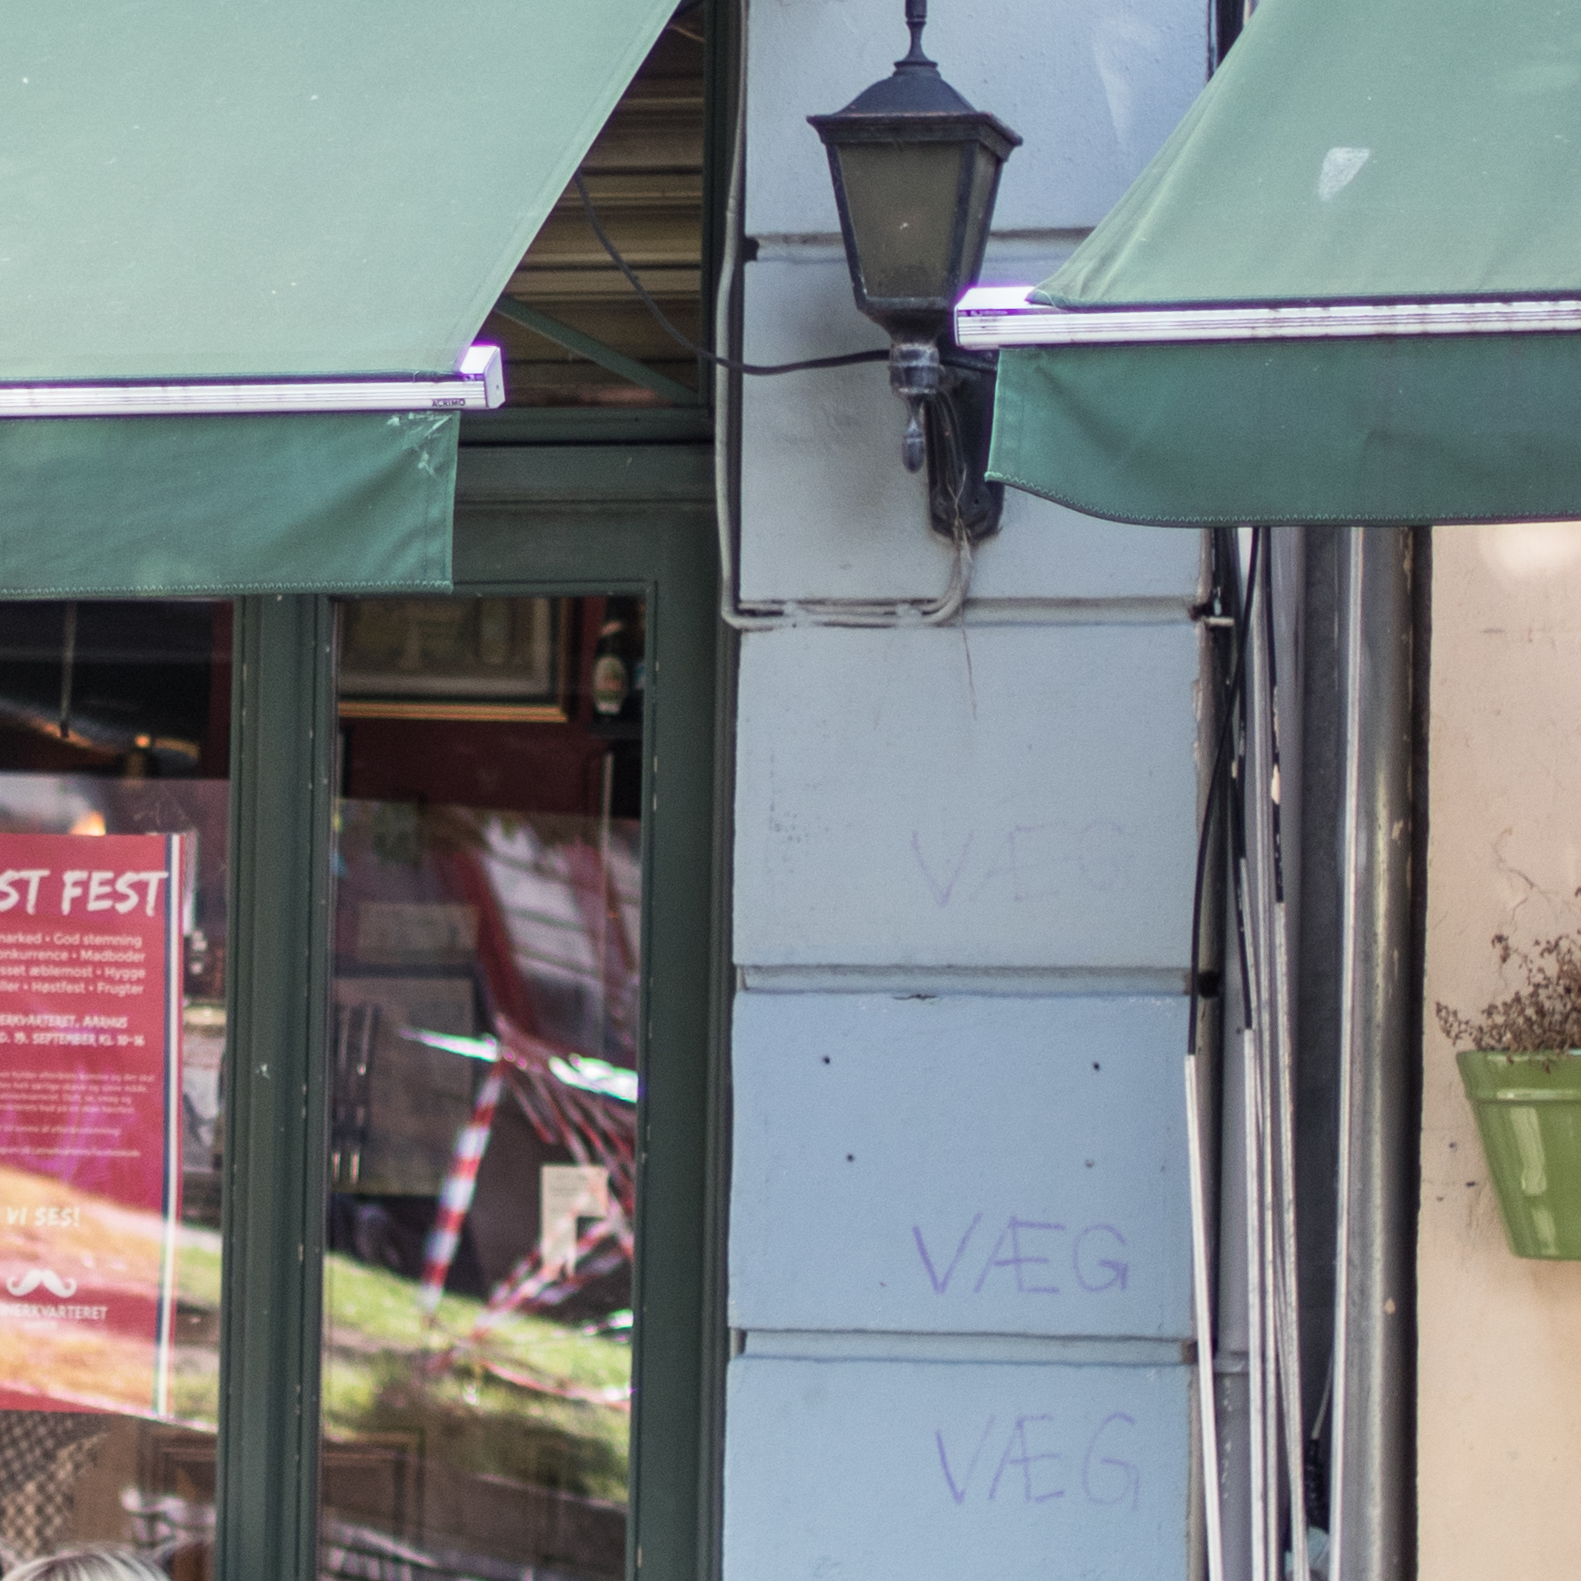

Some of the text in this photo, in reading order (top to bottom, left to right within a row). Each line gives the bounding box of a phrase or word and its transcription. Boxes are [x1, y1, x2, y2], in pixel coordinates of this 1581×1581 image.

[60, 869, 169, 917] FEST
[54, 933, 80, 946] God
[82, 934, 142, 949] stemning
[104, 965, 146, 982] Hygge
[31, 981, 86, 995] Høstfest
[96, 981, 144, 998] Frugter
[6, 1206, 80, 1228] VI SES!
[913, 1212, 1128, 1294] VÆG
[935, 1413, 1139, 1511] VÆG
